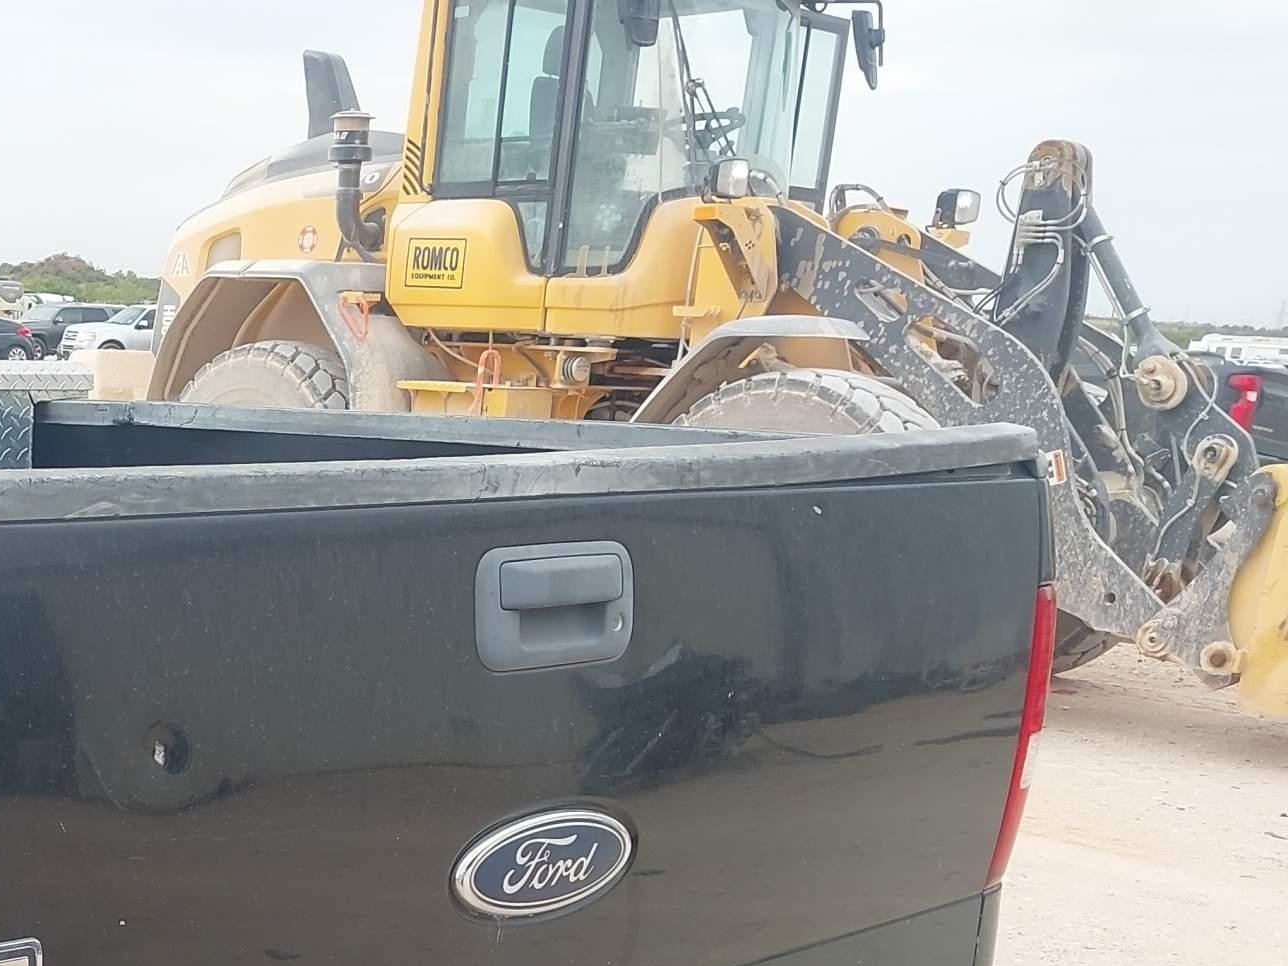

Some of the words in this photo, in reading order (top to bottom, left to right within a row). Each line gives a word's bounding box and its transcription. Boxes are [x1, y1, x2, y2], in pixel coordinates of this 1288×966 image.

[412, 246, 460, 271] ROMCO
[410, 272, 445, 281] EQUIPMENT
[502, 834, 599, 895] Ford
